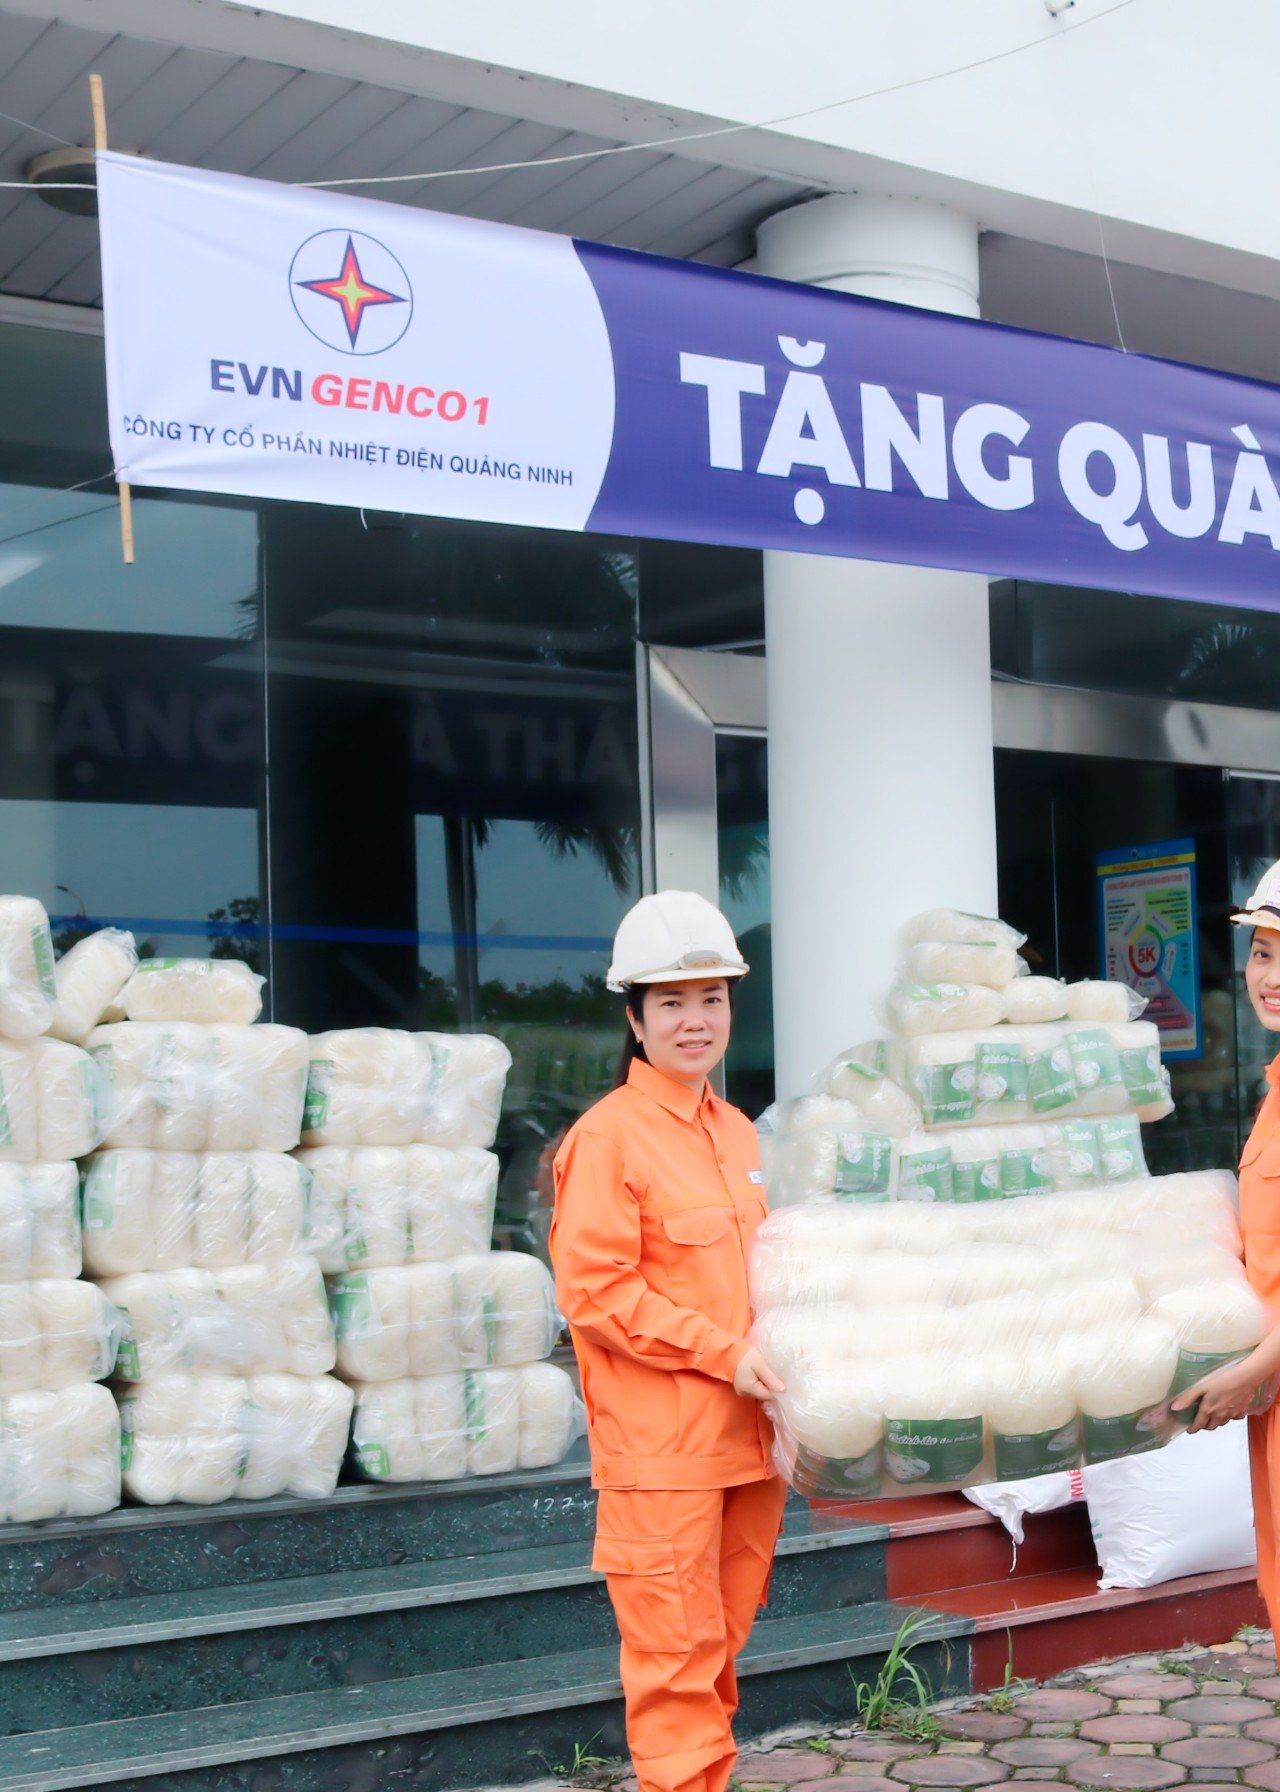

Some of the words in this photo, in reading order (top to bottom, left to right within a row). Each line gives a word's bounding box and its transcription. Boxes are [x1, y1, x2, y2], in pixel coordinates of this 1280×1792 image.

[210, 359, 302, 401] EVN
[311, 373, 491, 426] GENCO1
[188, 424, 215, 444] TY
[223, 424, 254, 448] CỔ
[329, 440, 391, 466] NHIỆT
[396, 447, 443, 472] ĐIỆN
[449, 454, 521, 480] QUẢNG
[527, 466, 573, 486] NINH
[679, 335, 1035, 527] TẶNG
[1137, 945, 1156, 964] 5K
